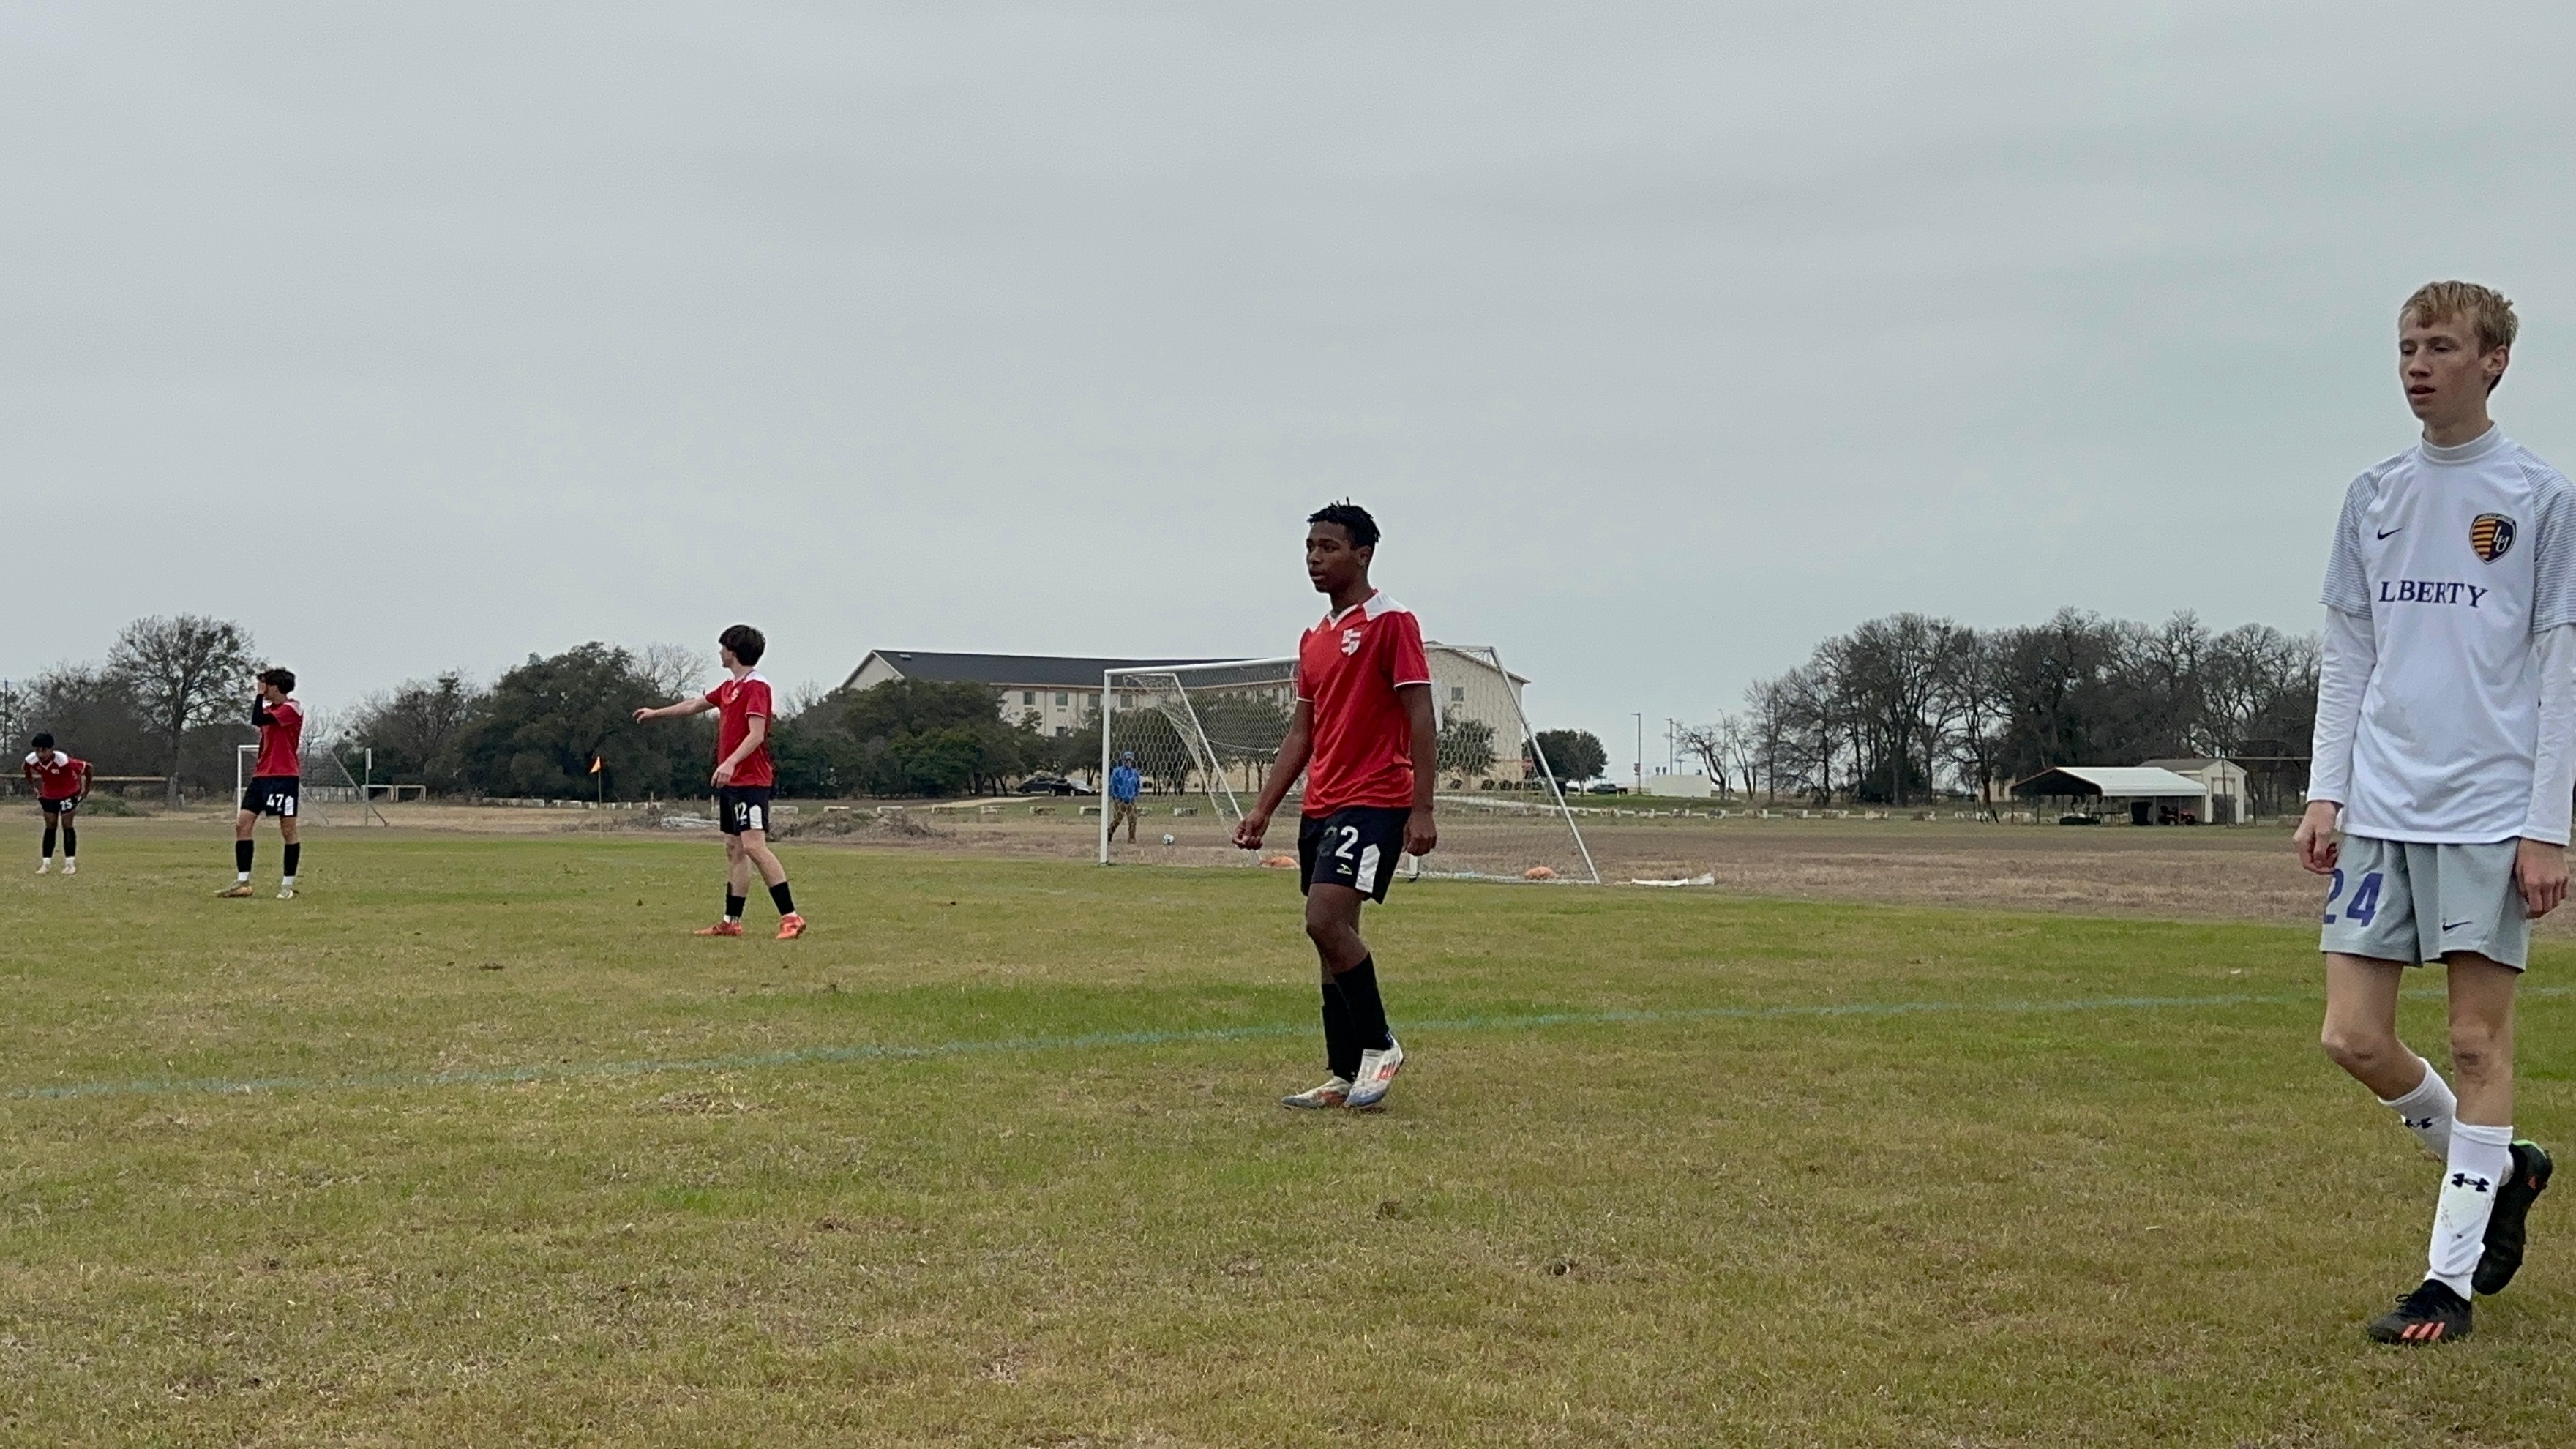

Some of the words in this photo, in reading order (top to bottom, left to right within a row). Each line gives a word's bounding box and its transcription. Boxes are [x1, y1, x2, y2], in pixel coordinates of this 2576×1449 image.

[2378, 580, 2488, 608] LBERTY
[60, 798, 73, 812] 25
[266, 793, 285, 807] 47
[734, 801, 748, 822] 12
[2324, 868, 2384, 927] 24
